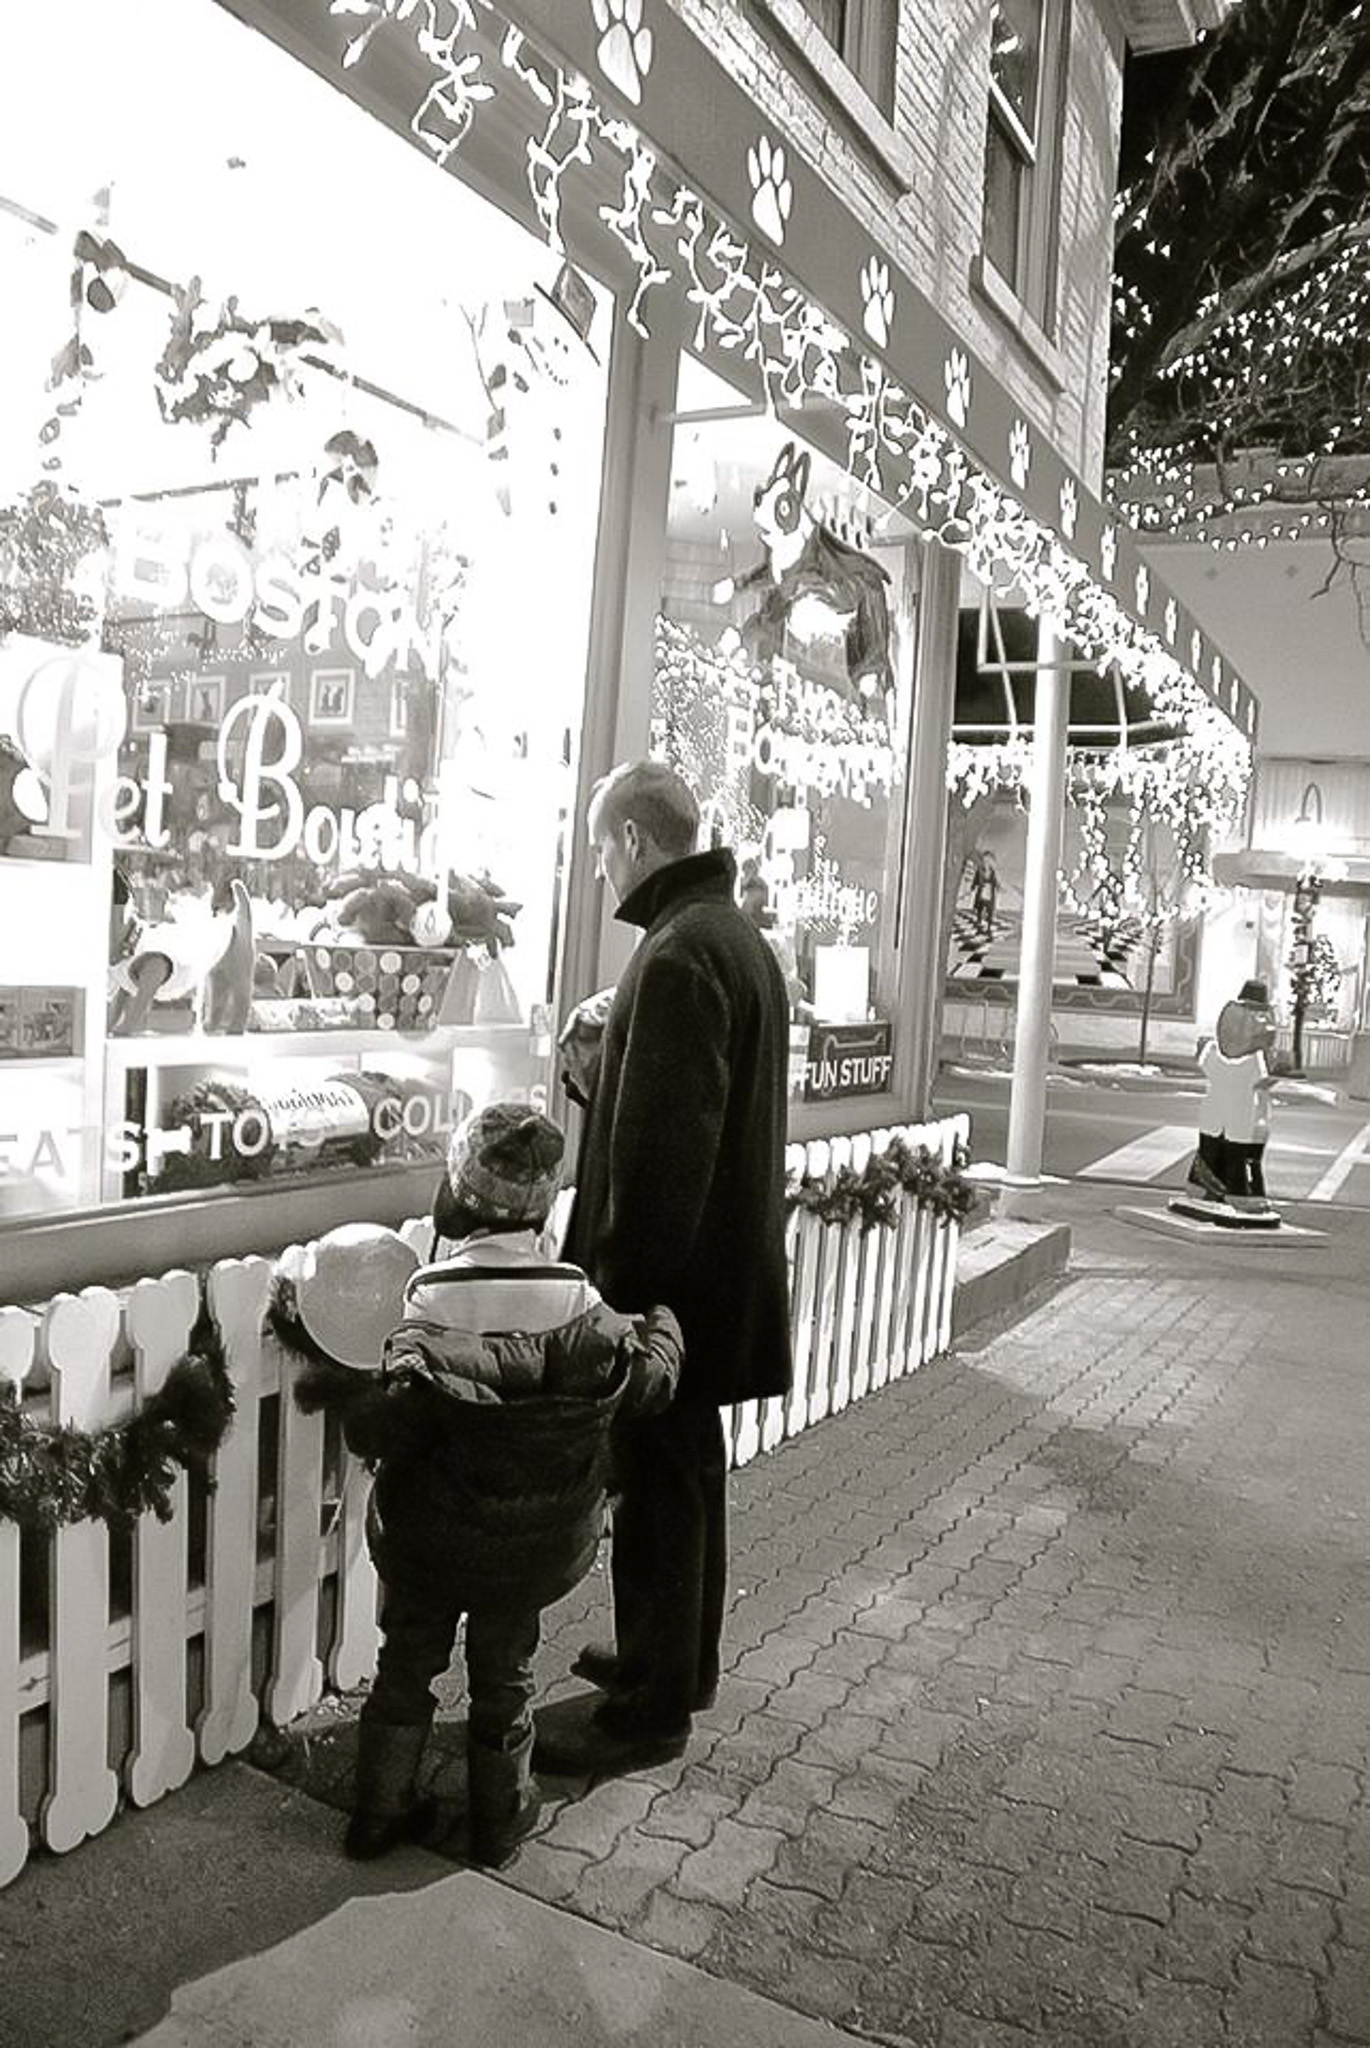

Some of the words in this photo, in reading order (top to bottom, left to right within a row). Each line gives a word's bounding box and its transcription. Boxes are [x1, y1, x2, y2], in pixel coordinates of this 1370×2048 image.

[16, 650, 173, 848] Pet
[217, 675, 440, 872] Bouti
[800, 1060, 838, 1091] FUN
[840, 1055, 892, 1087] STUFF
